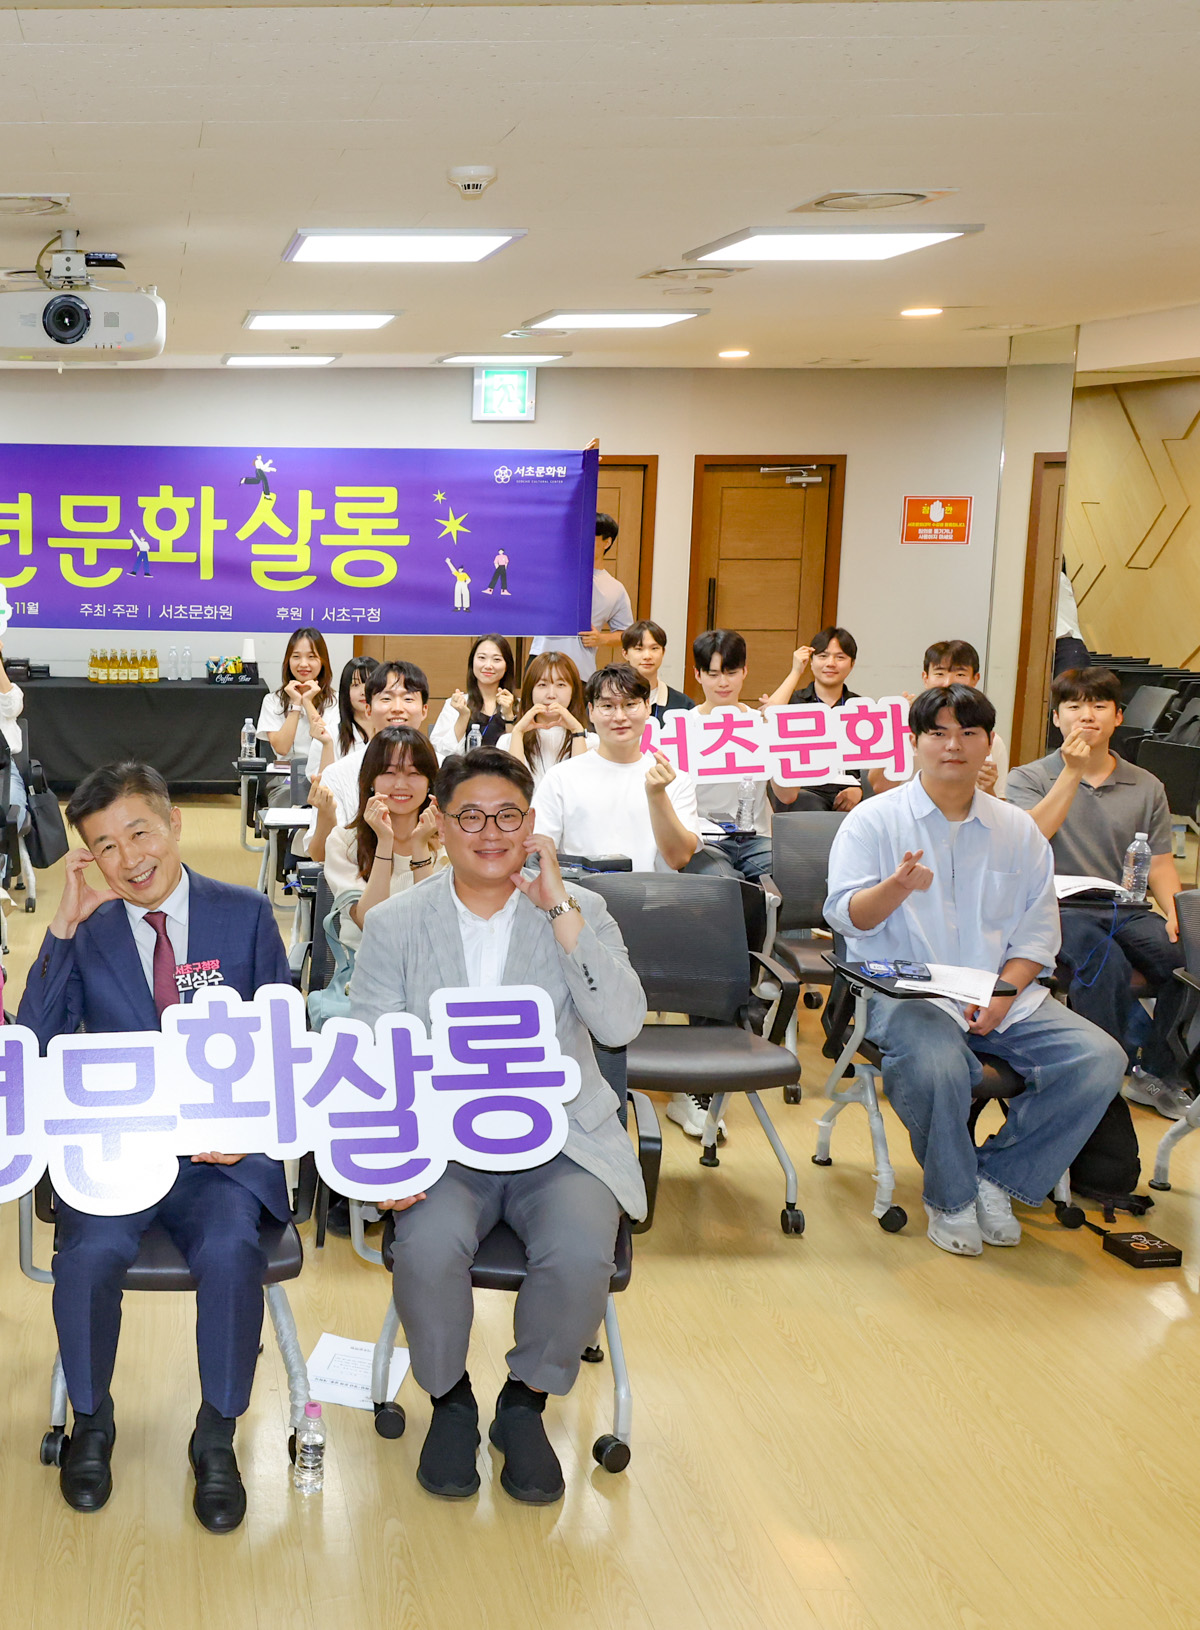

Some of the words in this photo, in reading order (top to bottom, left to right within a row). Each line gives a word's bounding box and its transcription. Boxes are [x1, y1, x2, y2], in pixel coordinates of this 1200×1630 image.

[514, 465, 567, 478] 서초문화원
[79, 603, 139, 618] 주최·주관
[158, 604, 233, 620] 서초문화원
[275, 607, 303, 621] 후원
[321, 607, 381, 623] 서초구청
[215, 674, 234, 684] Coffee
[238, 674, 252, 683] Bar
[640, 703, 912, 779] 서초문화
[175, 959, 220, 975] 서초구청장
[175, 969, 224, 992] 전성수
